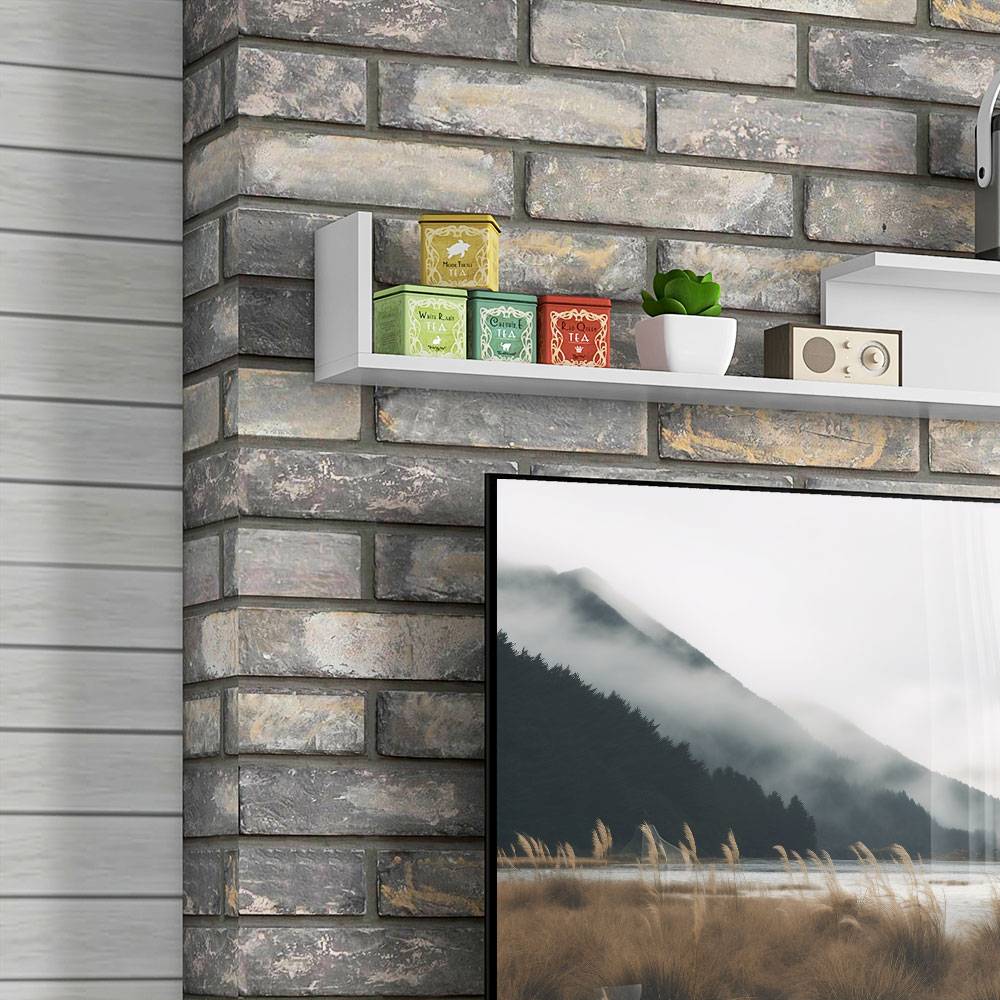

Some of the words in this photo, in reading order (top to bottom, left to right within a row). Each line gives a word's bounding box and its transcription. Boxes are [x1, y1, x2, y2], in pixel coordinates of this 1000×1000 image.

[426, 321, 447, 332] TEA
[497, 328, 516, 338] TEA
[568, 332, 590, 342] TEA
